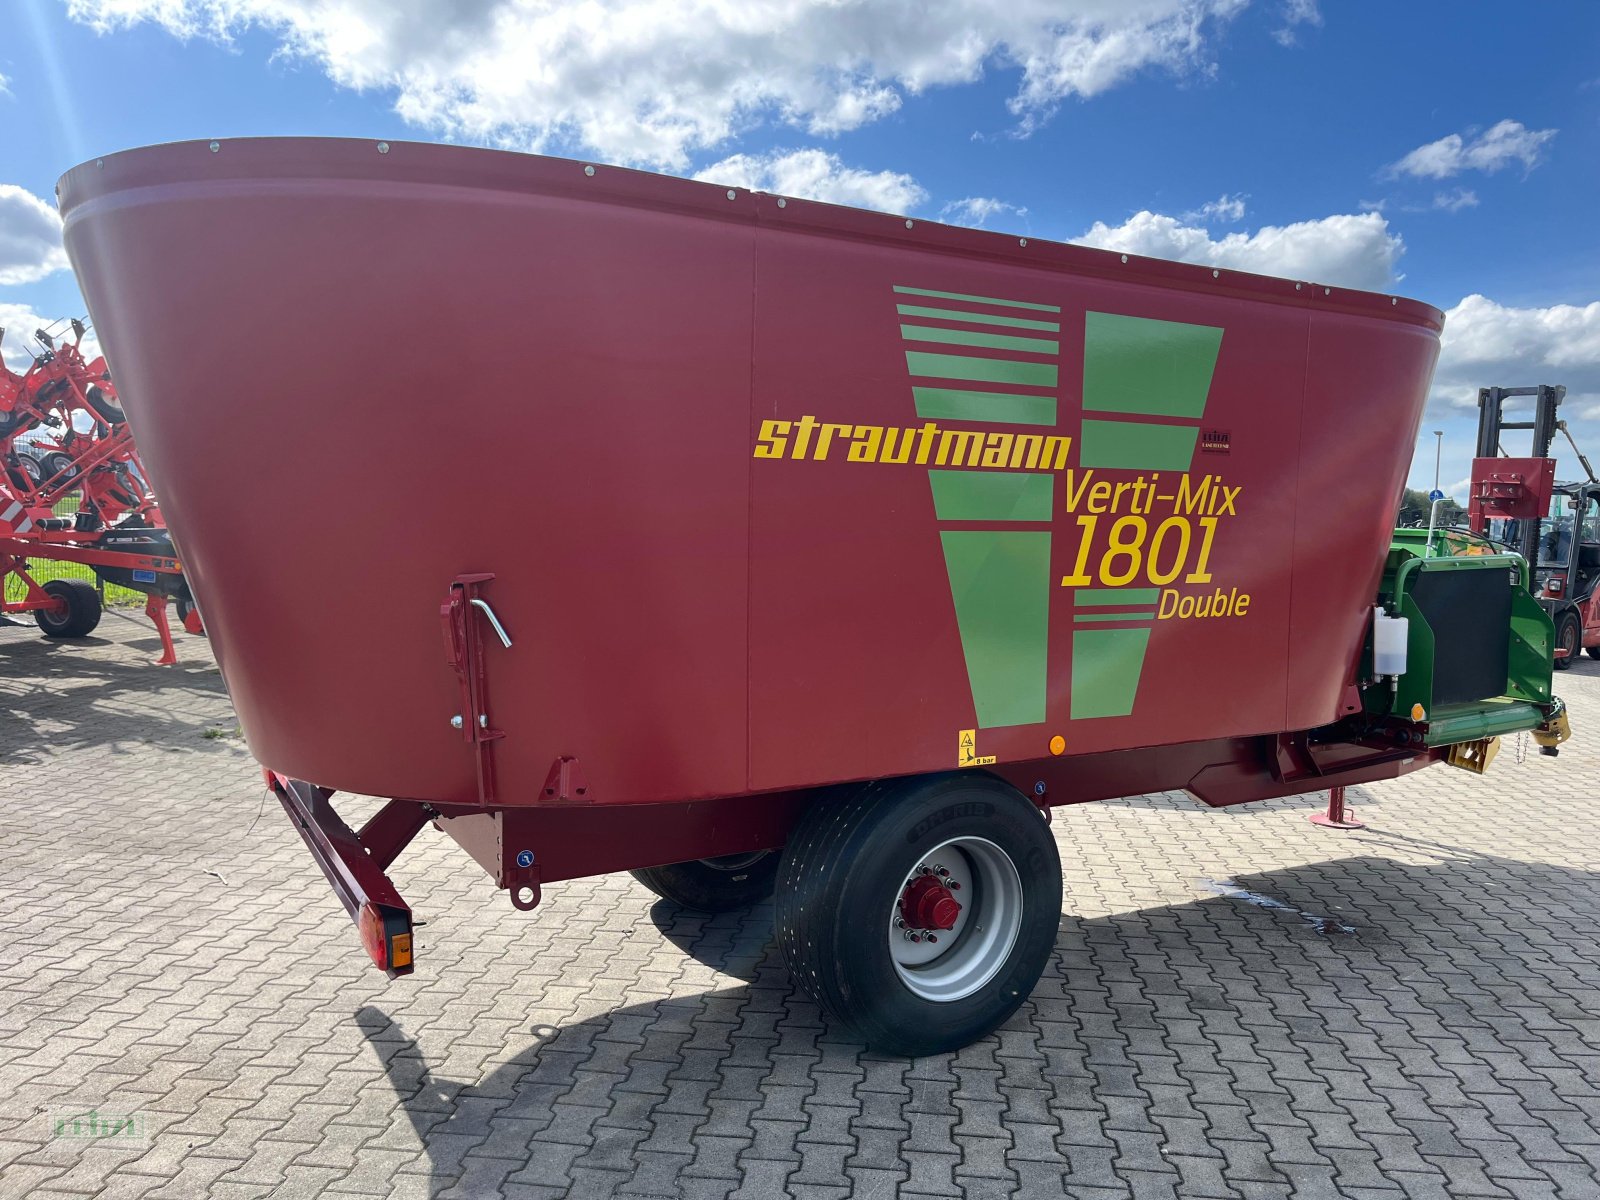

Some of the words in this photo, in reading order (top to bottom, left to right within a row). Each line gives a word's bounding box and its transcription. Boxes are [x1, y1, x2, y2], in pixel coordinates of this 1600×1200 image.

[753, 415, 1072, 470] strautmann
[1066, 468, 1241, 516] Verti-Mix
[1061, 515, 1218, 587] 1801
[1158, 588, 1251, 620] Double
